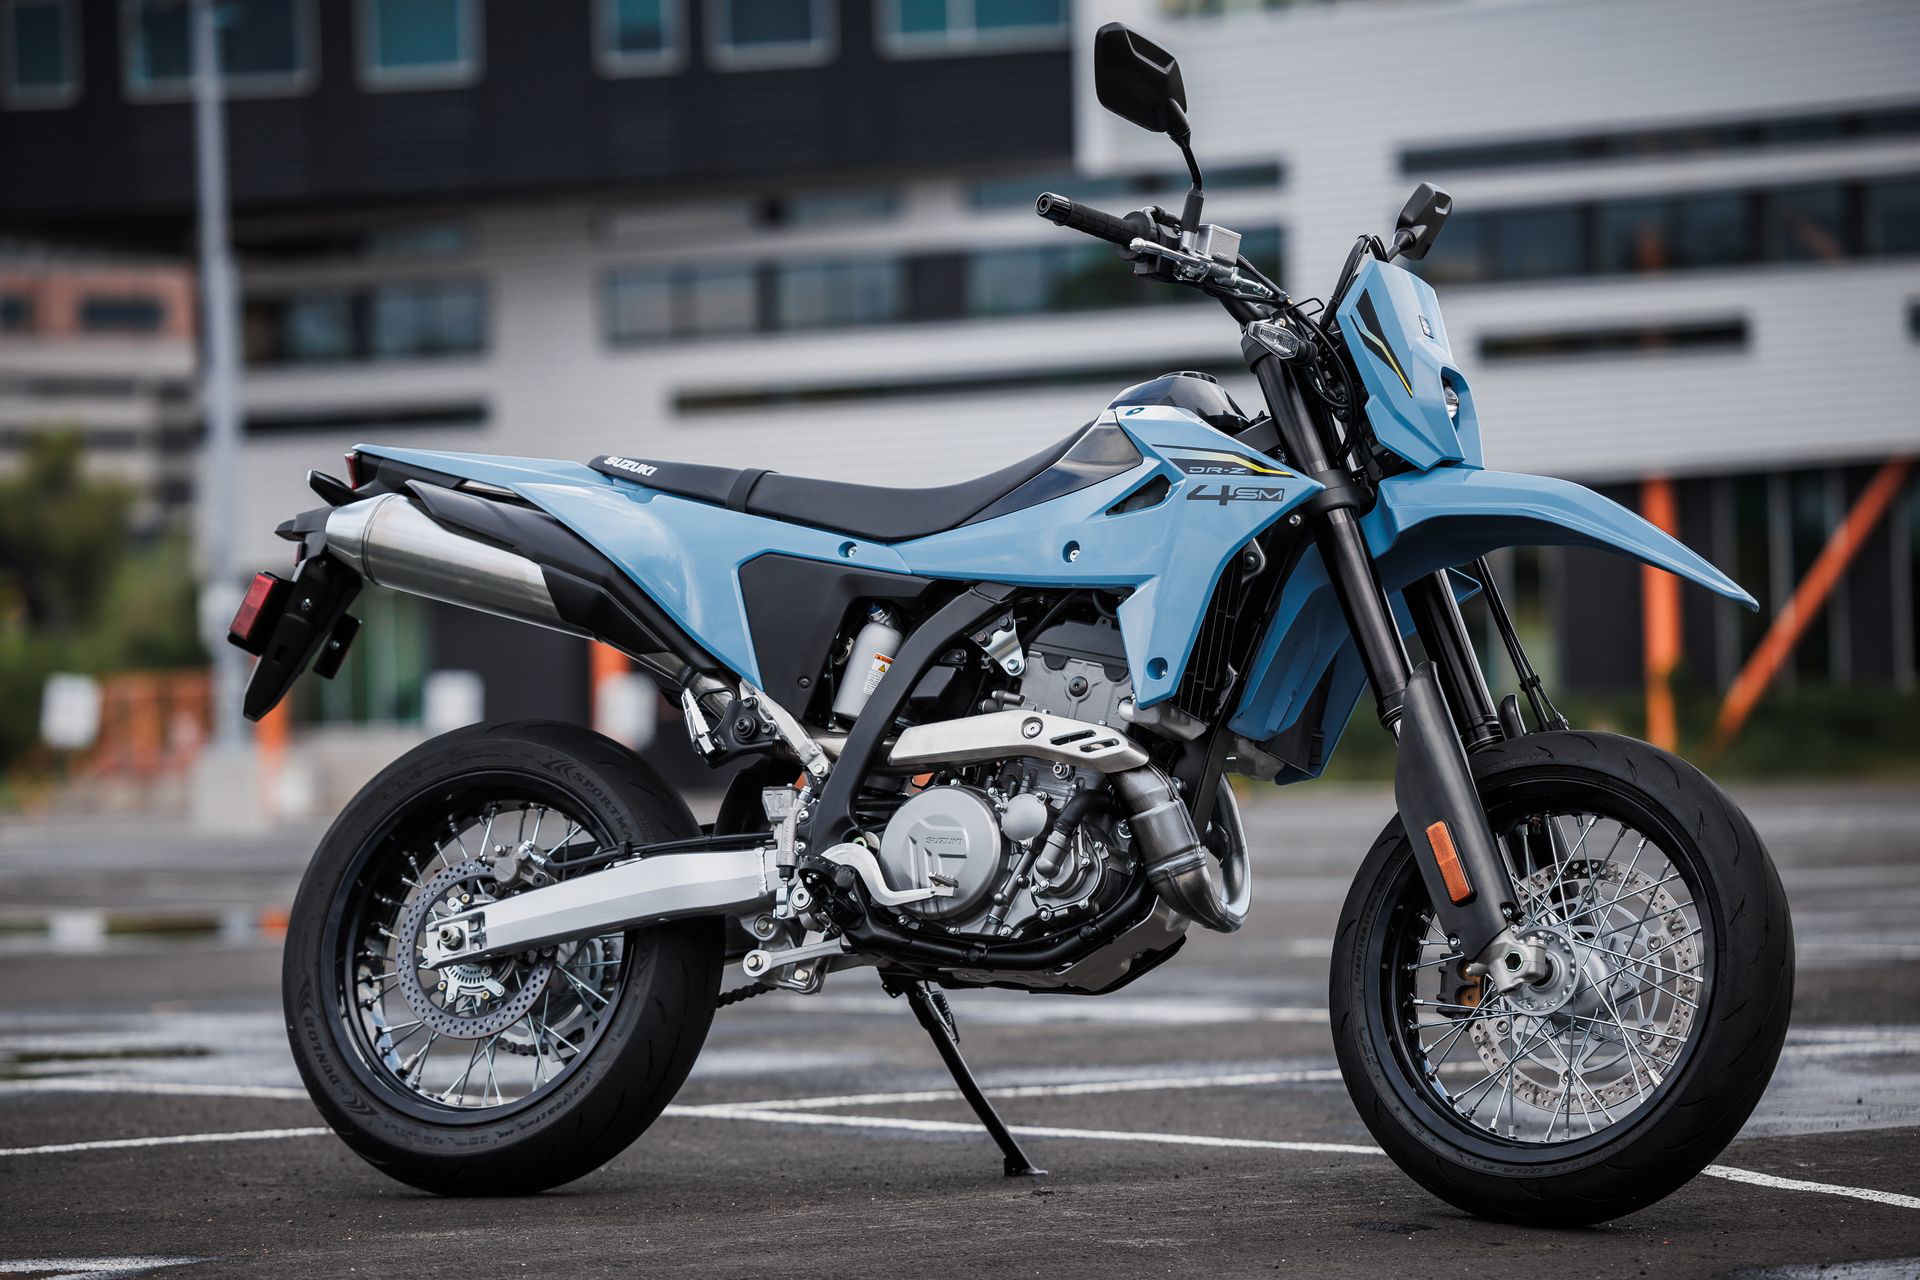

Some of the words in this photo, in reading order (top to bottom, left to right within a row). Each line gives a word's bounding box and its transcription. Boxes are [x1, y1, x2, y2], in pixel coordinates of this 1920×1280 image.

[603, 456, 658, 477] SUZUKI
[1188, 466, 1248, 475] DR-Z
[1186, 484, 1285, 506] 4SM
[573, 771, 635, 842] SPORTMA
[926, 836, 963, 846] SUZUKI
[303, 1015, 342, 1086] DUNLOP
